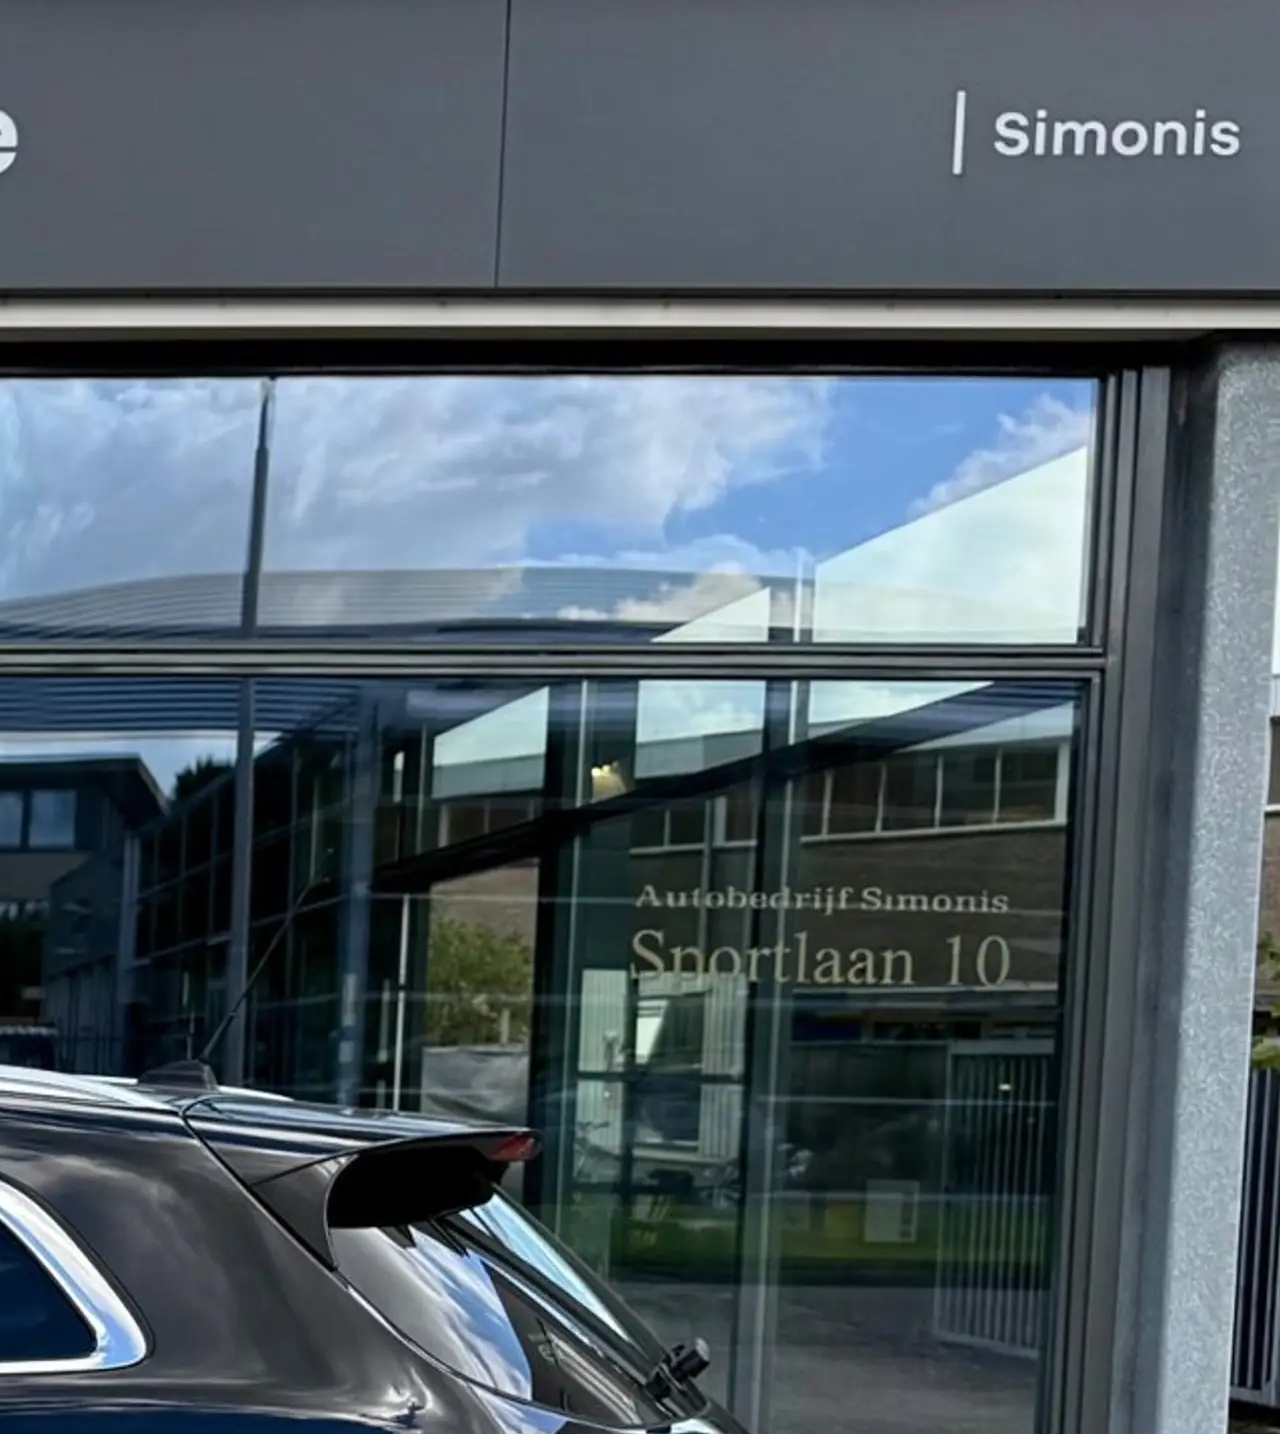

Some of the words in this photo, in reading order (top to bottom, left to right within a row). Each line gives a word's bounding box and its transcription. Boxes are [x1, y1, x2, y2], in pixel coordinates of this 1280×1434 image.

[993, 108, 1241, 157] Simonis
[635, 884, 849, 916] Autobedrijf
[859, 887, 1010, 914] Simonis
[945, 934, 1011, 988] 10
